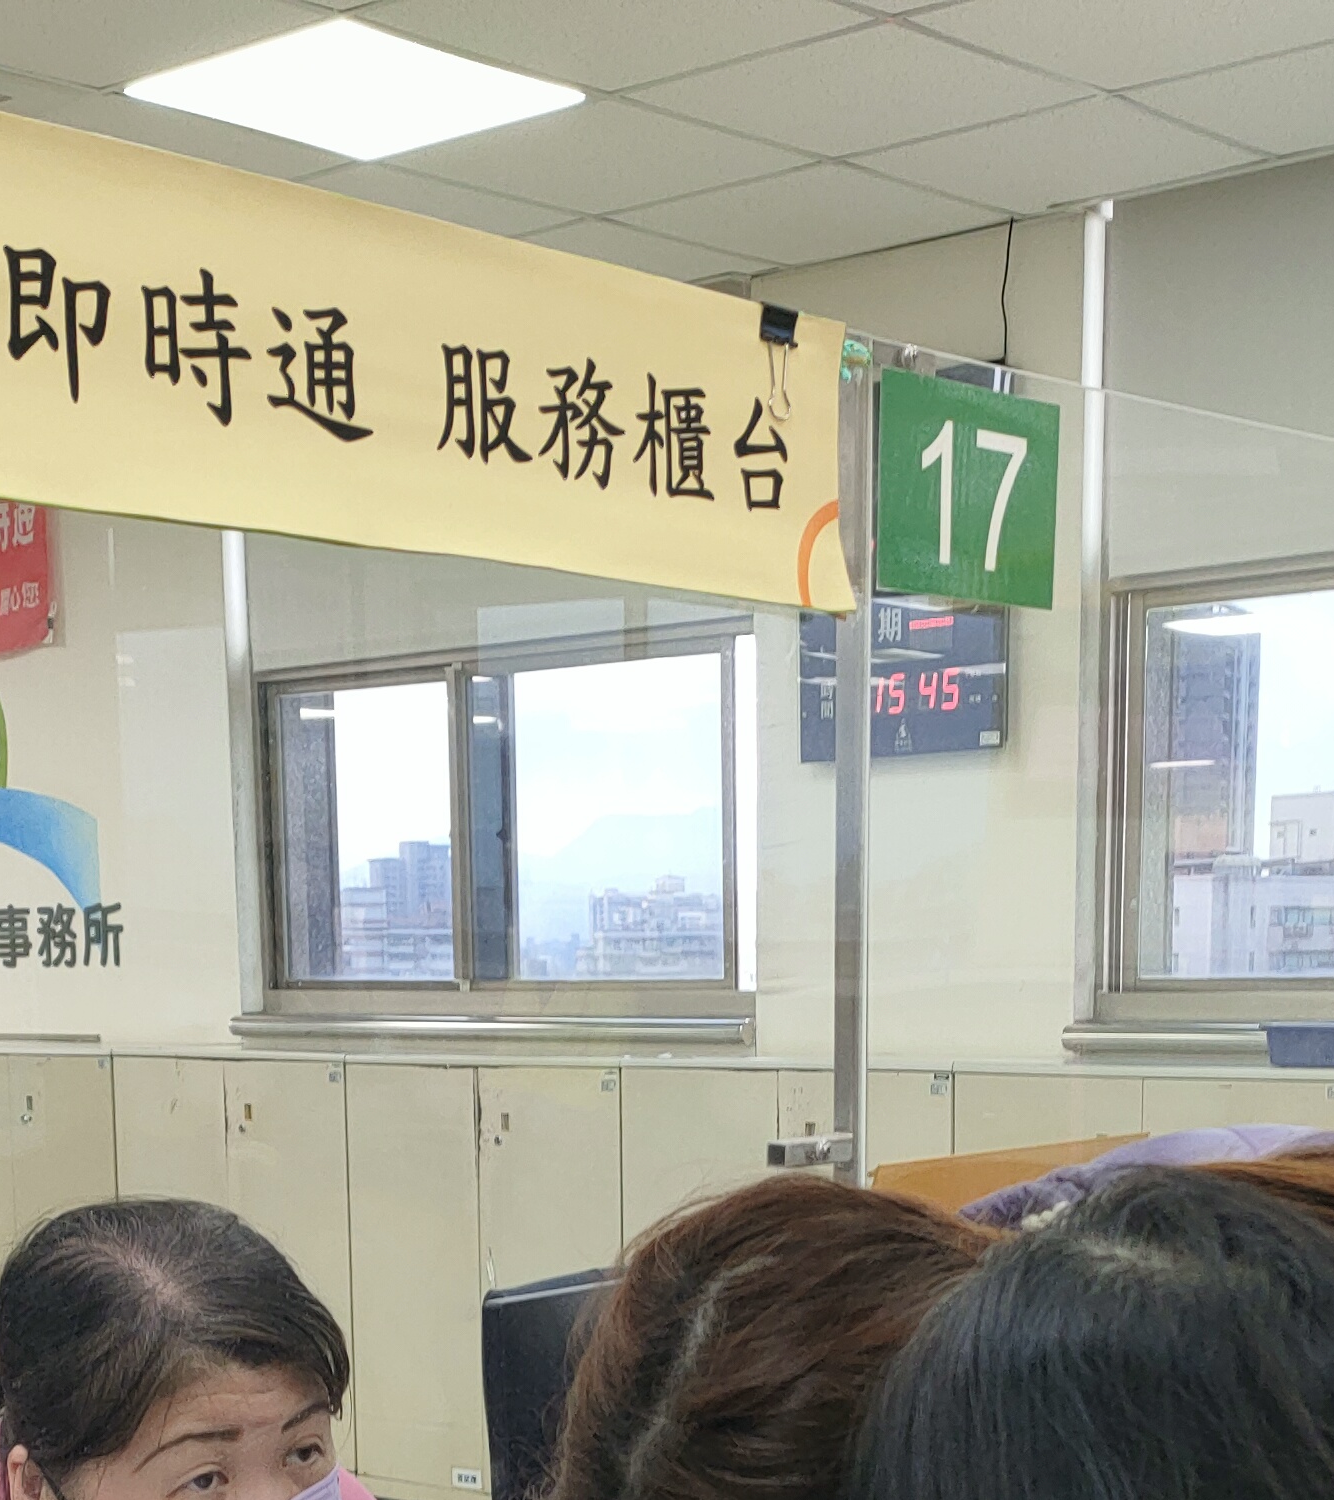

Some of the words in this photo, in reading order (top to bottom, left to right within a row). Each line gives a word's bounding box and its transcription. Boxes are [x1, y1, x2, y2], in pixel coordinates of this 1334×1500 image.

[436, 343, 790, 512] 服務櫃台
[921, 419, 1028, 572] 17
